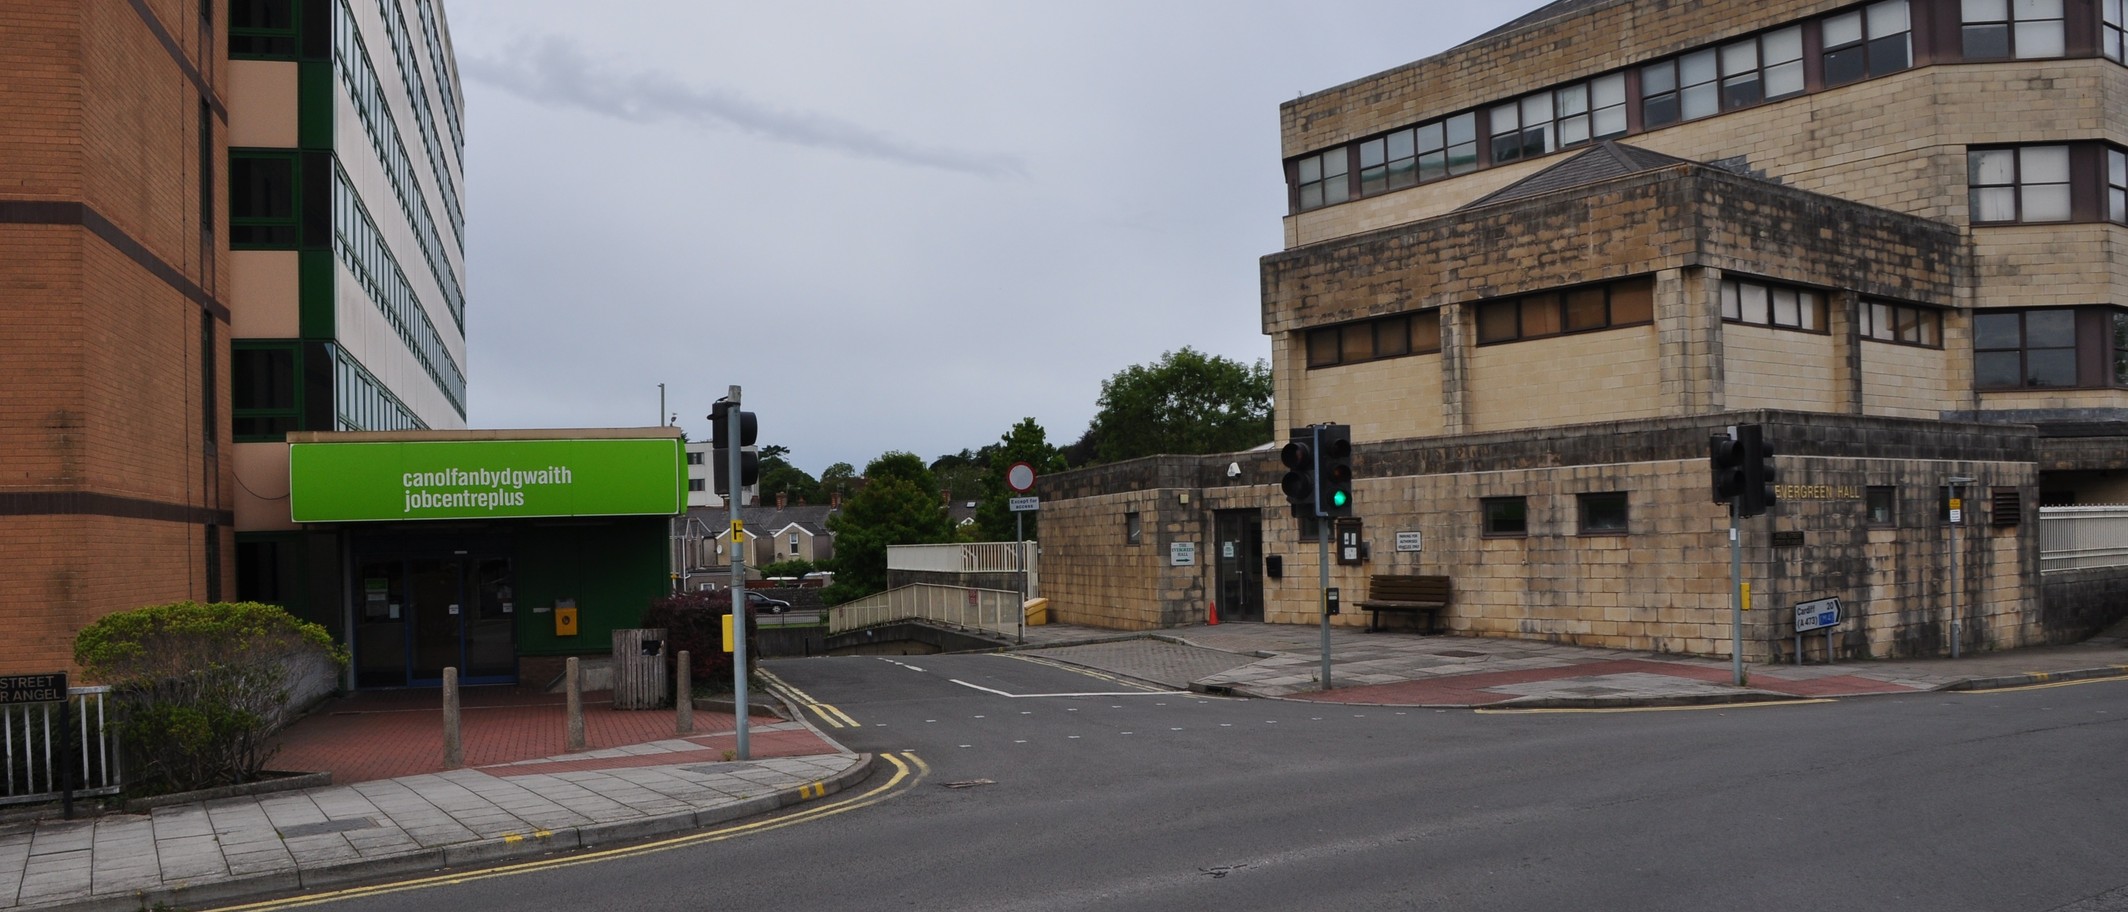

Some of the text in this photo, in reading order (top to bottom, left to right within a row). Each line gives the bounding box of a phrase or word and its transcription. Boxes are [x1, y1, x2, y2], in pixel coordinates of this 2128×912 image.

[403, 466, 572, 488] canolfanbydgwaith
[1774, 485, 1860, 499] EVERGREEN HALL
[404, 488, 524, 512] jobcentreplus
[1797, 601, 1834, 616] Cardiff 20
[0, 676, 54, 689] STREET
[12, 689, 60, 701] ANGEL
